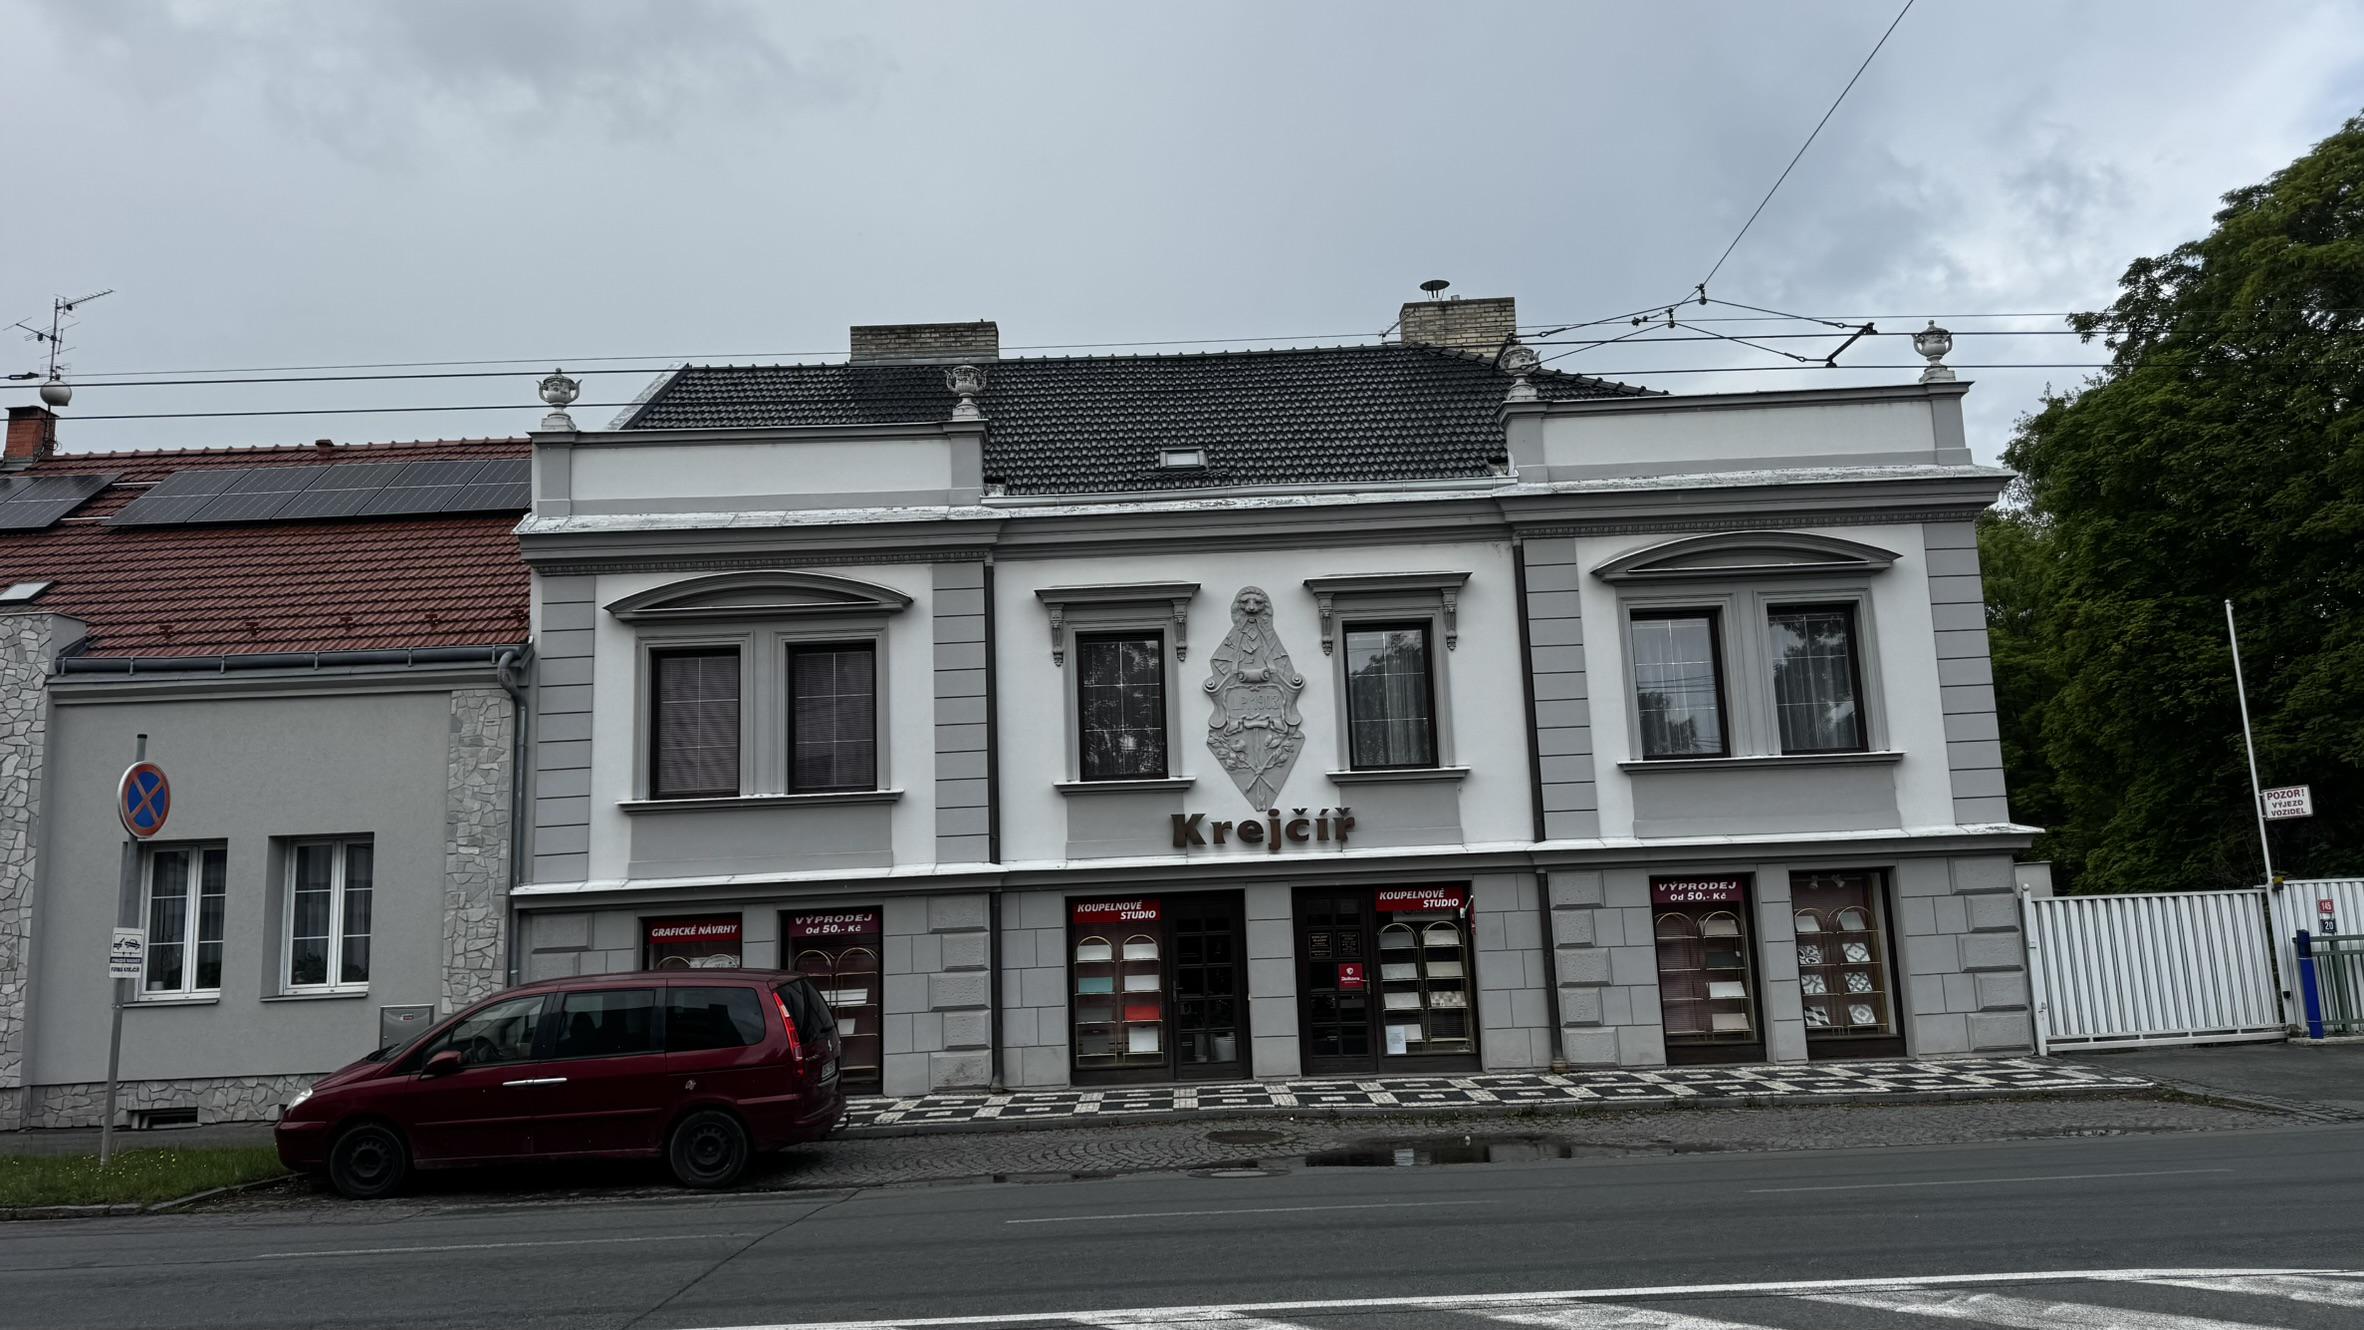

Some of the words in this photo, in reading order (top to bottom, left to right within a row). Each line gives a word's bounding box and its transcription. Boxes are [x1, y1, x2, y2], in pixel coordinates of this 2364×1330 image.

[2267, 788, 2305, 800] POZOR!
[2272, 799, 2304, 809] VÝJEZD
[2271, 807, 2307, 817] VOZIDEL
[1171, 807, 1355, 851] Krejčíř
[1658, 881, 1737, 892] VÝPRODEJ
[1379, 887, 1445, 901] KOUPELNOVÉ
[1670, 893, 1684, 901] Od
[1687, 891, 1711, 901] 50,-
[1713, 891, 1727, 900] Kč
[1077, 900, 1143, 913] KOUPELNOVÉ
[1423, 897, 1459, 909] STUDIO
[794, 913, 873, 925] VÝPRODEJ
[1120, 909, 1156, 921] STUDIO
[651, 924, 697, 938] GRAFICKÉ
[697, 923, 737, 936] NÁVRHY
[805, 926, 820, 935] Od
[822, 924, 846, 934] 50,-
[847, 923, 862, 933] Kč
[2324, 921, 2334, 931] 20
